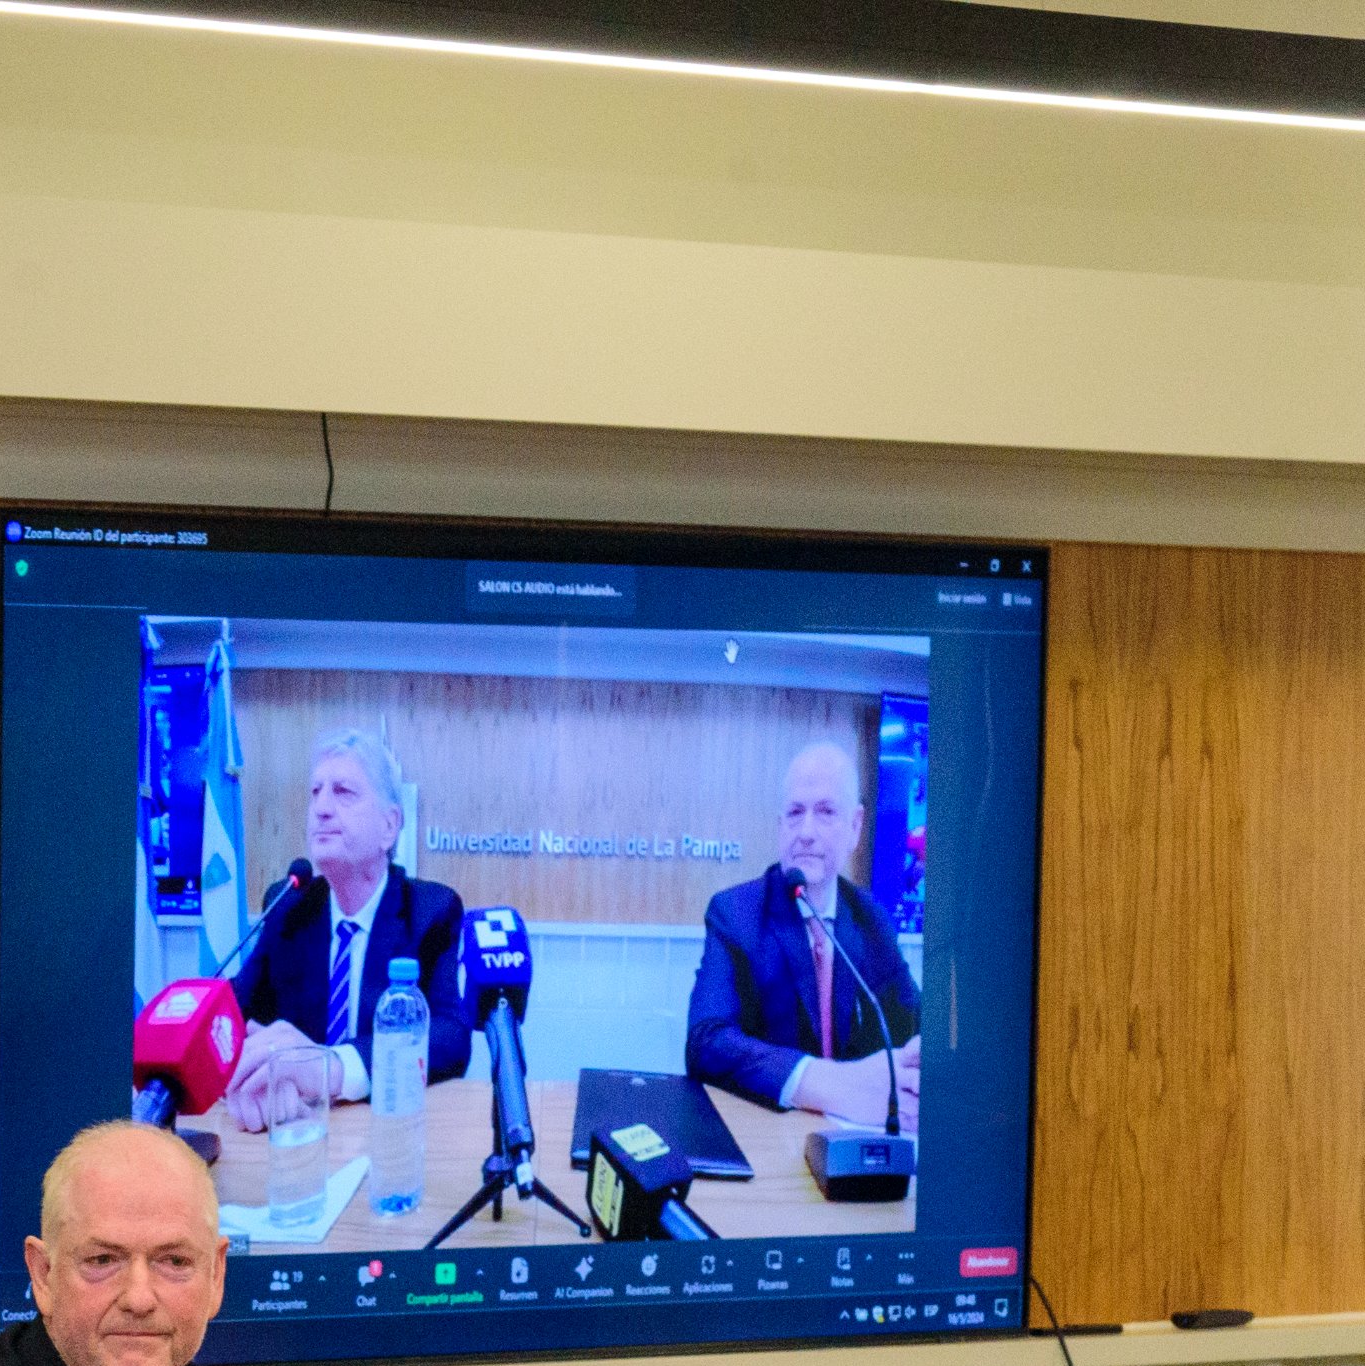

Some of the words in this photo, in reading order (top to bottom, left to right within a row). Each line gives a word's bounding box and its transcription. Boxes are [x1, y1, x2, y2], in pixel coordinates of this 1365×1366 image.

[24, 526, 52, 540] Zoom
[53, 527, 92, 542] Reunión
[93, 529, 104, 542] ID
[105, 528, 119, 543] del
[524, 581, 556, 595] AUDIO
[425, 826, 532, 852] Universidad
[538, 829, 620, 855] Nacional
[626, 832, 648, 856] de
[653, 833, 675, 857] La
[682, 832, 743, 862] Pampa
[481, 951, 525, 969] TVPP
[251, 1298, 308, 1313] Participantes
[356, 1294, 377, 1307] Chat
[406, 1292, 449, 1307] Compartir
